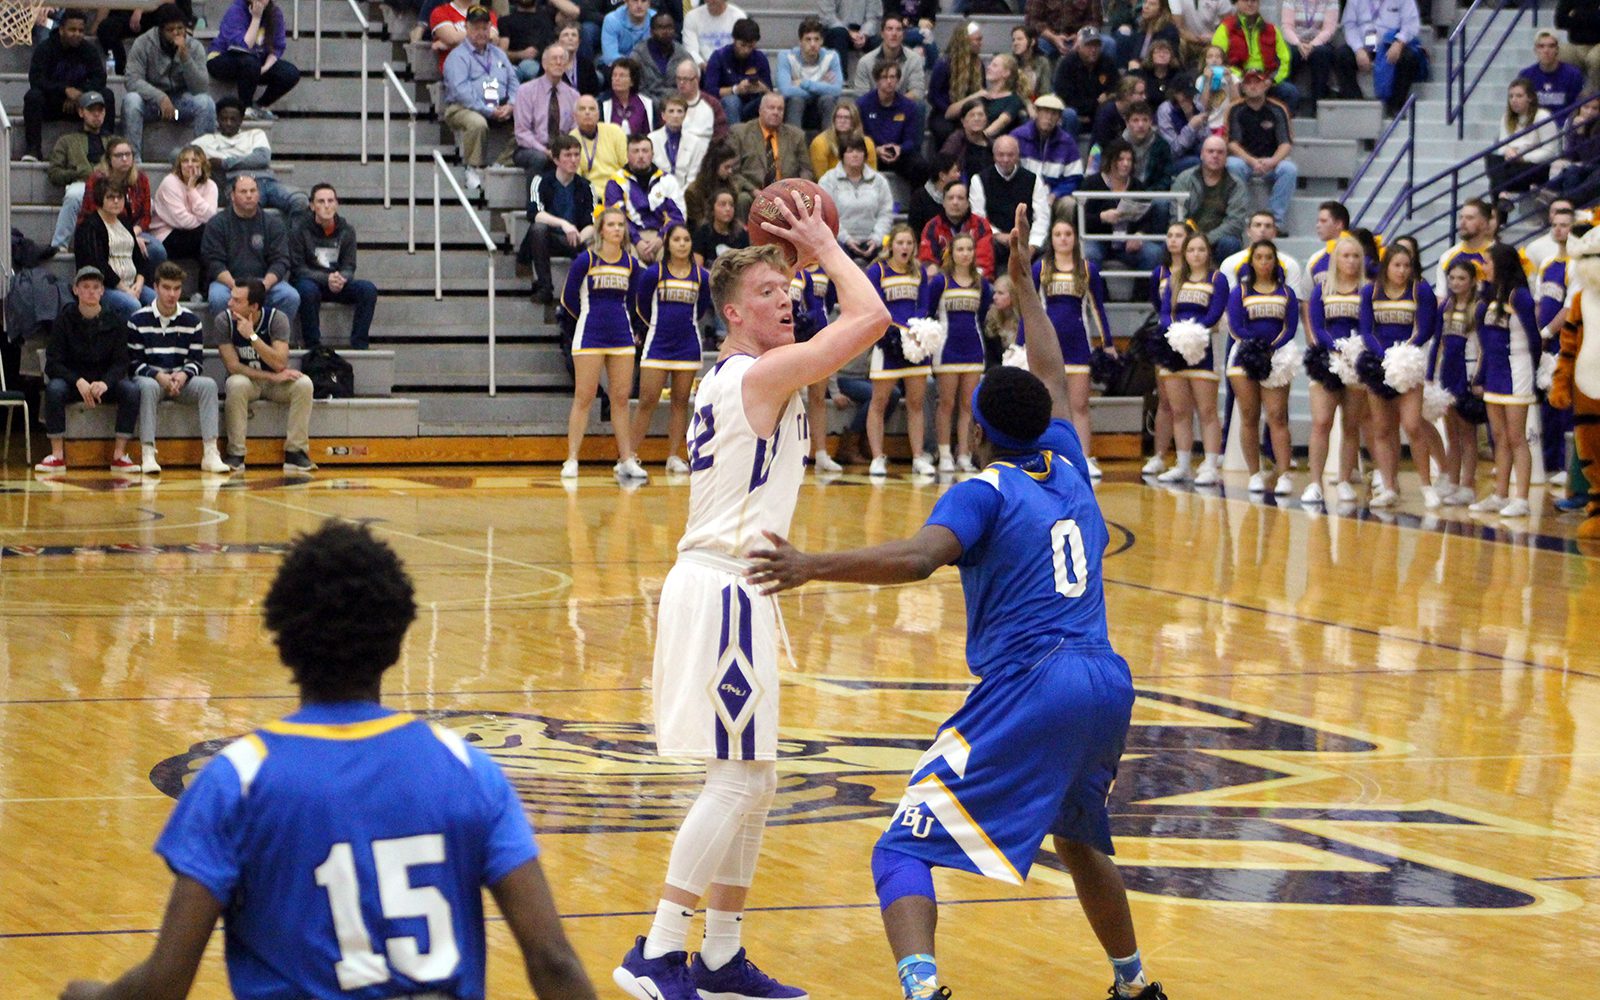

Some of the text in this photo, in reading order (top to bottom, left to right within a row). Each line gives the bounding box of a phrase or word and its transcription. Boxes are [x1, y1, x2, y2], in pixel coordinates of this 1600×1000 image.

[592, 274, 630, 291] TIGERS
[658, 287, 698, 304] TIGERS
[886, 286, 919, 302] TIGERS
[1177, 290, 1210, 307] GERS
[945, 297, 980, 313] TIGERS
[1247, 303, 1286, 320] TIGERS
[1374, 310, 1413, 325] TIGERS
[1050, 518, 1088, 598] 0
[720, 683, 747, 697] ONU
[900, 804, 935, 839] BU
[314, 833, 460, 991] 15
